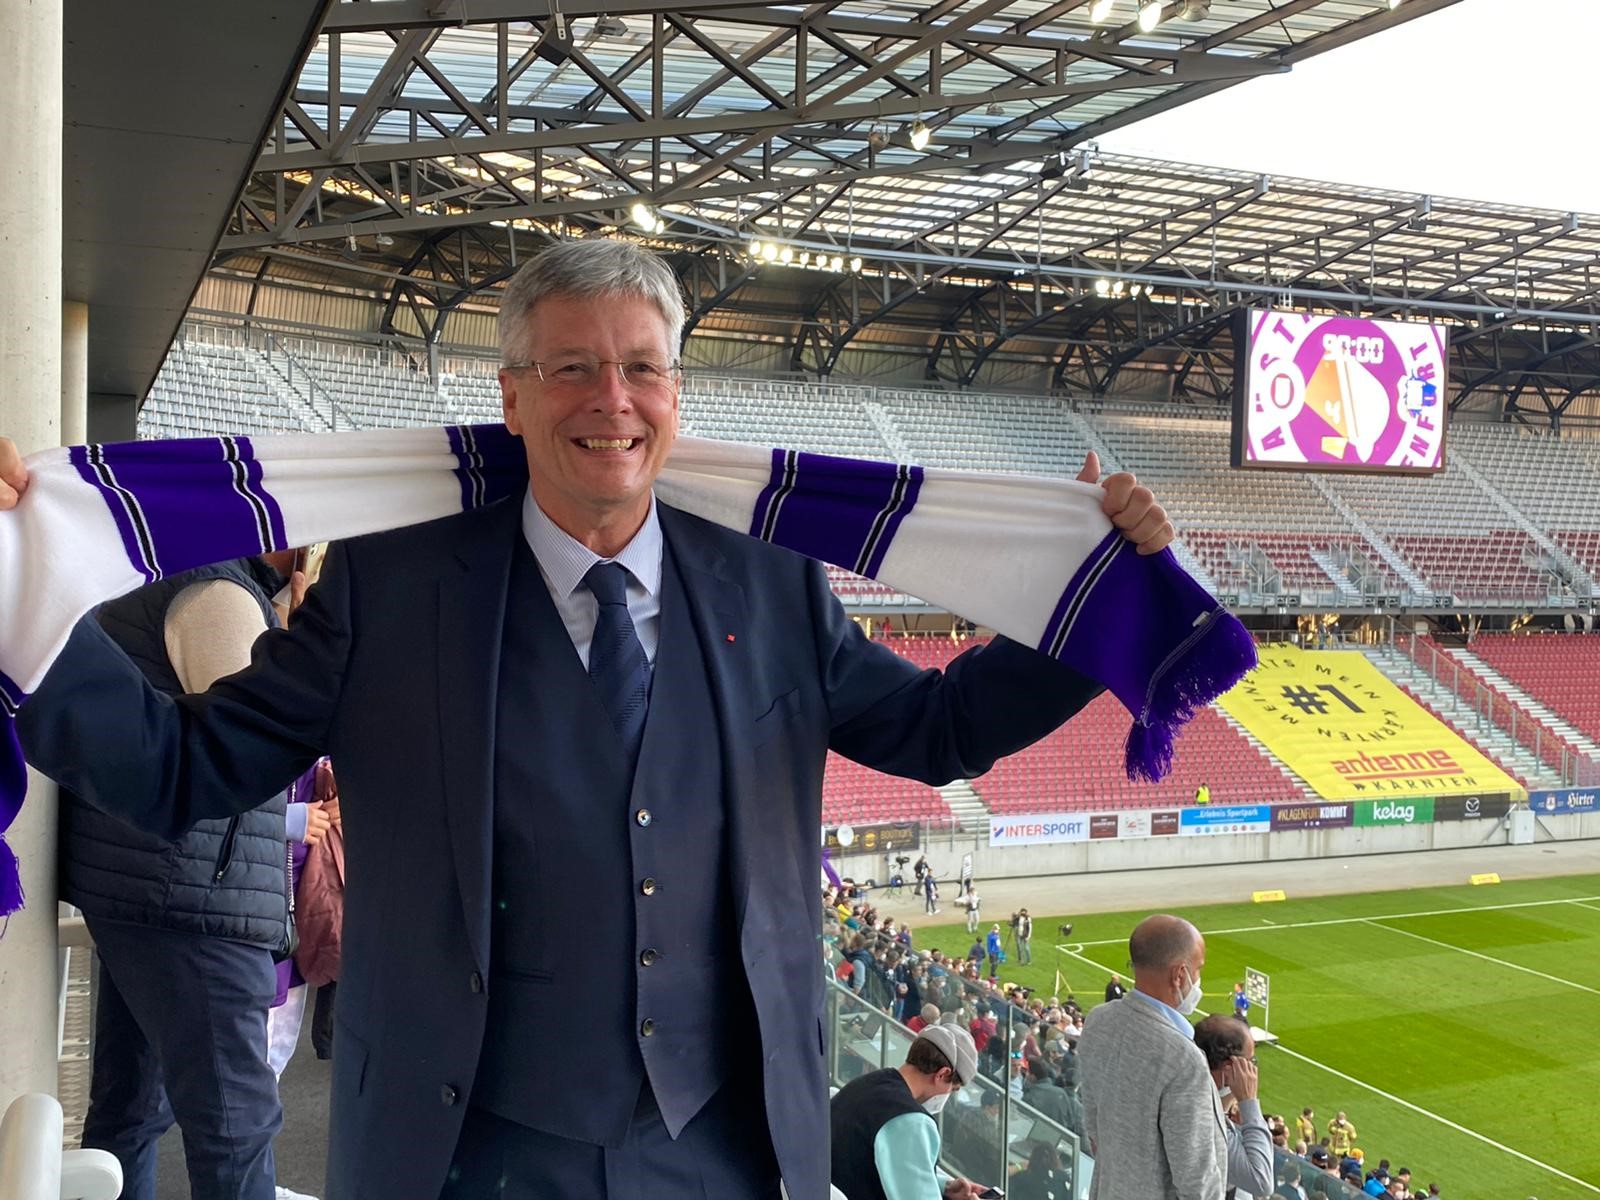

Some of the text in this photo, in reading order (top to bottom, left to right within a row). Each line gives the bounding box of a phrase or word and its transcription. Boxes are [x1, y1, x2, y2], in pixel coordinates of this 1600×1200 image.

[1280, 684, 1366, 715] #1
[1330, 749, 1459, 775] antenne
[1373, 801, 1415, 822] kelag
[1005, 822, 1083, 838] INTERSPORT
